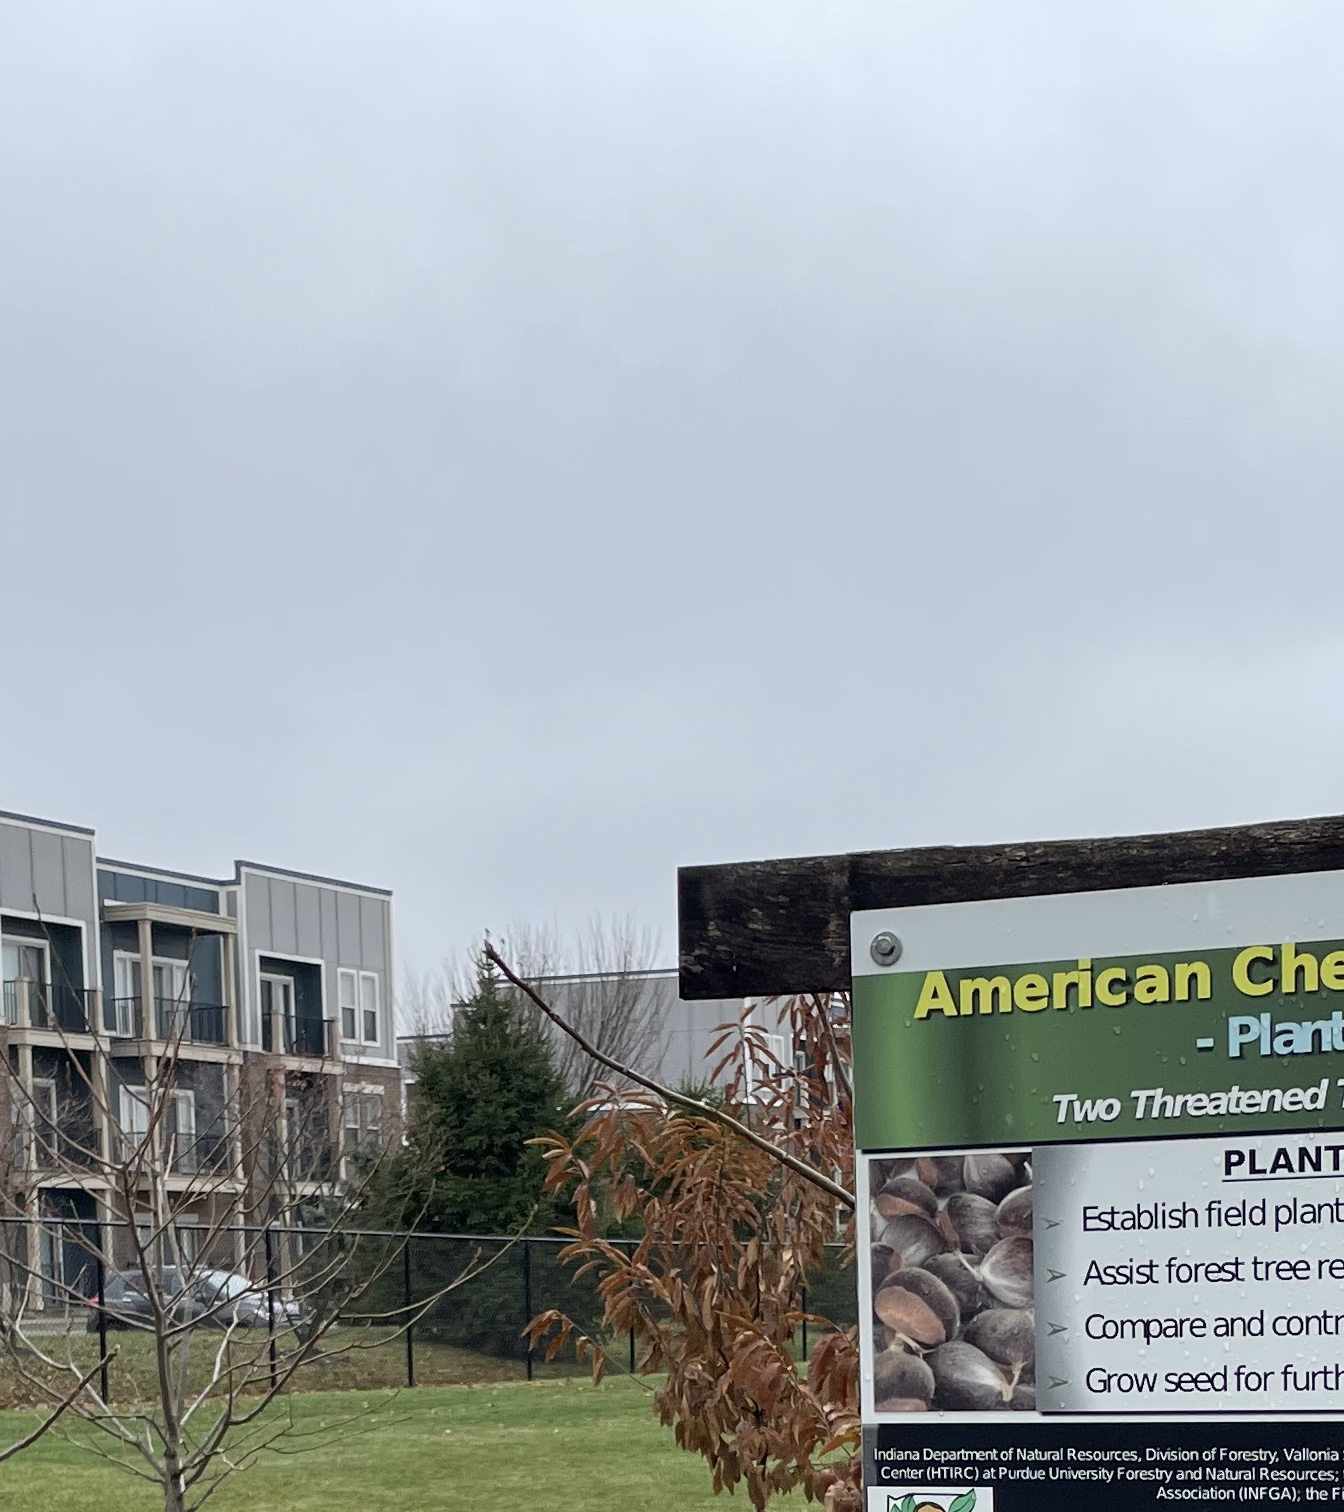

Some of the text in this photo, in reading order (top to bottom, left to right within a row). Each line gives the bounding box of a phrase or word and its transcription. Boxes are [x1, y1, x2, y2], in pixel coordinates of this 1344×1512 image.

[914, 957, 1213, 1019] American
[1197, 1036, 1214, 1049] -
[1052, 1093, 1122, 1124] Two
[1130, 1078, 1329, 1121] Threatened
[1083, 1200, 1199, 1232] Establish
[1205, 1198, 1266, 1230] field
[1083, 1257, 1160, 1287] Assist
[1165, 1254, 1245, 1285] forest
[1251, 1254, 1312, 1282] tree
[1084, 1312, 1207, 1344] Compare
[1213, 1309, 1265, 1338] and
[1085, 1366, 1158, 1394] Grow
[1164, 1363, 1228, 1393] seed
[1233, 1364, 1275, 1393] for
[873, 1447, 920, 1461] Indiana
[923, 1448, 999, 1463] Department
[1000, 1447, 1014, 1461] of
[1016, 1447, 1064, 1461] Natural
[1145, 1447, 1200, 1462] Division
[1202, 1447, 1217, 1462] of
[1283, 1447, 1340, 1462] Vallonia
[880, 1466, 925, 1480] Center
[926, 1466, 979, 1482] (HTIRC)
[982, 1467, 997, 1480] at
[998, 1466, 1046, 1481] Purdue
[1048, 1466, 1115, 1483] University
[1116, 1467, 1174, 1484] Forestry
[1175, 1467, 1203, 1481] and
[1205, 1467, 1256, 1481] Natural
[1156, 1486, 1236, 1501] Association
[1305, 1486, 1329, 1501] the
